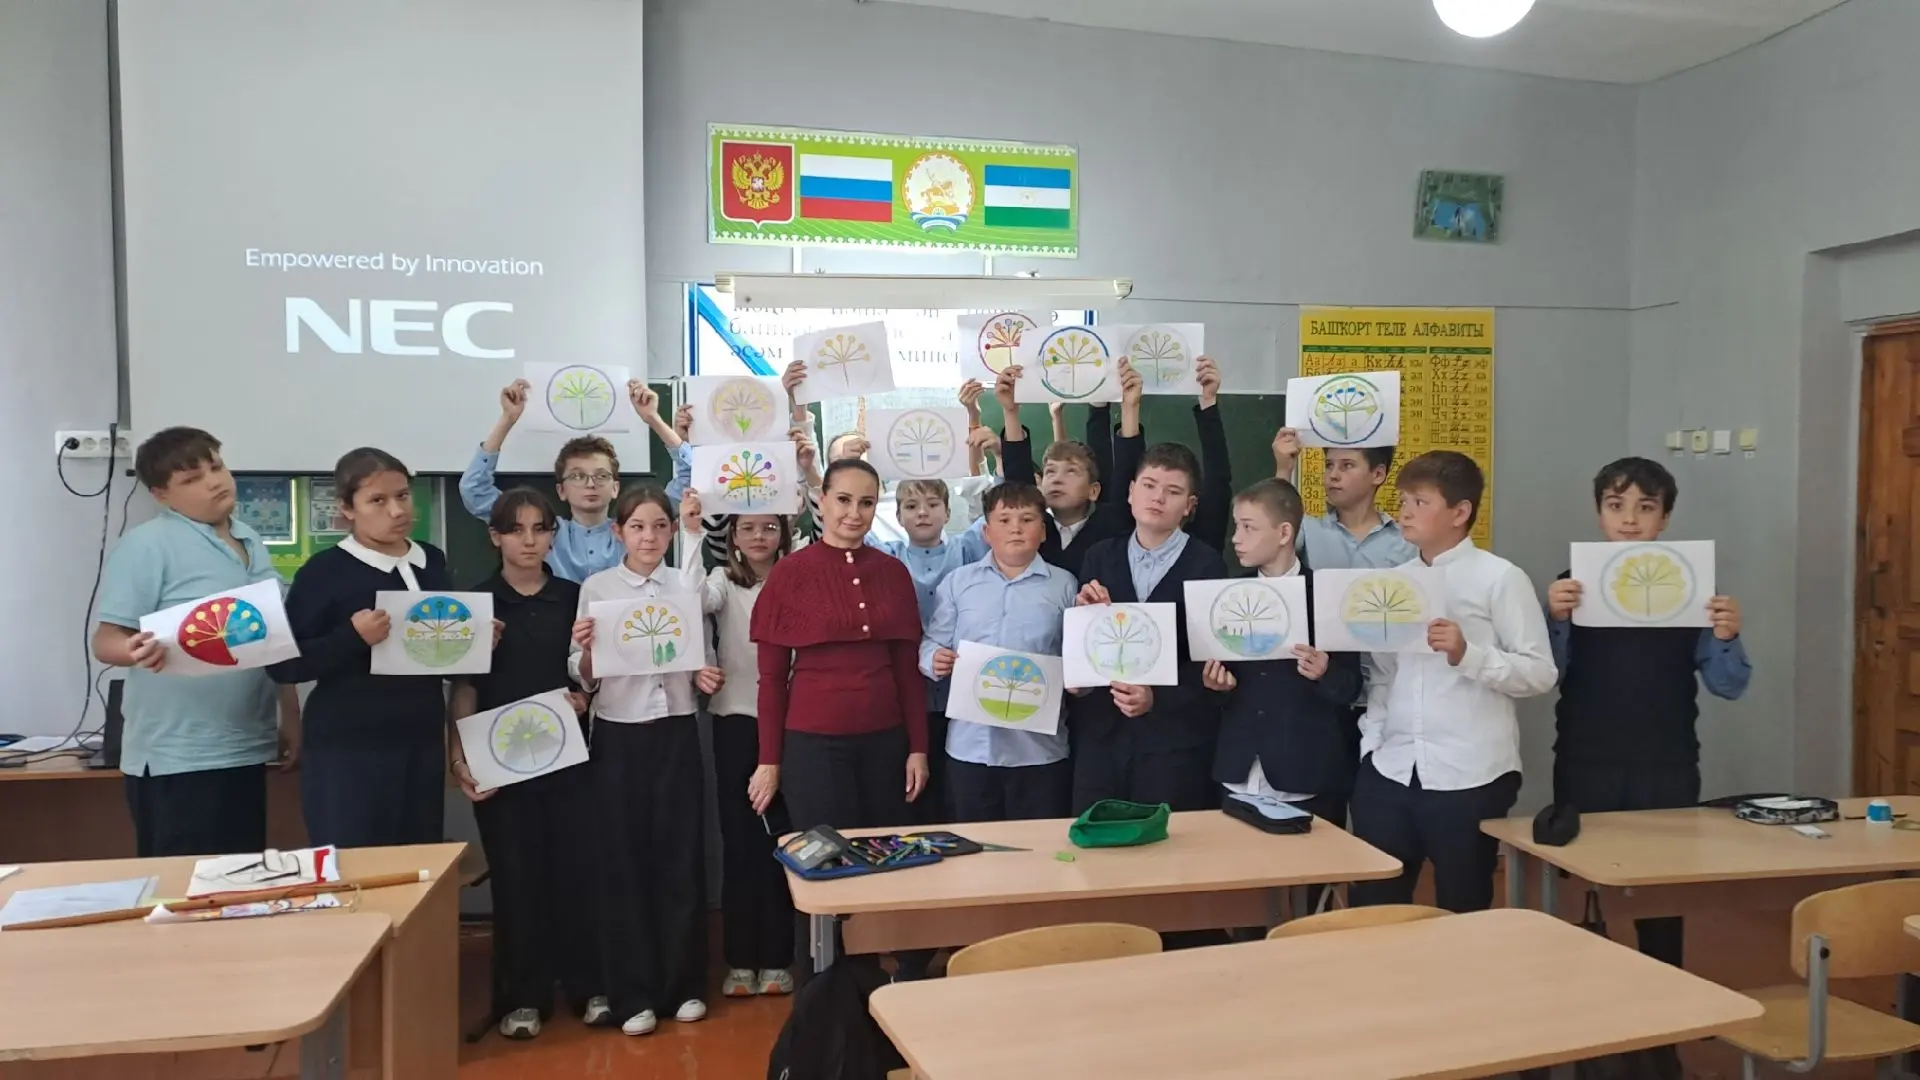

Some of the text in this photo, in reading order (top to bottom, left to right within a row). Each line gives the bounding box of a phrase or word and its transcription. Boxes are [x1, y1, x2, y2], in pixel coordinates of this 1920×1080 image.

[245, 248, 543, 276] Empowered by Innovation
[285, 297, 515, 358] NEC
[1376, 322, 1407, 336] ТЕЛЕ
[1413, 322, 1484, 337] АЛФАВИТЫ
